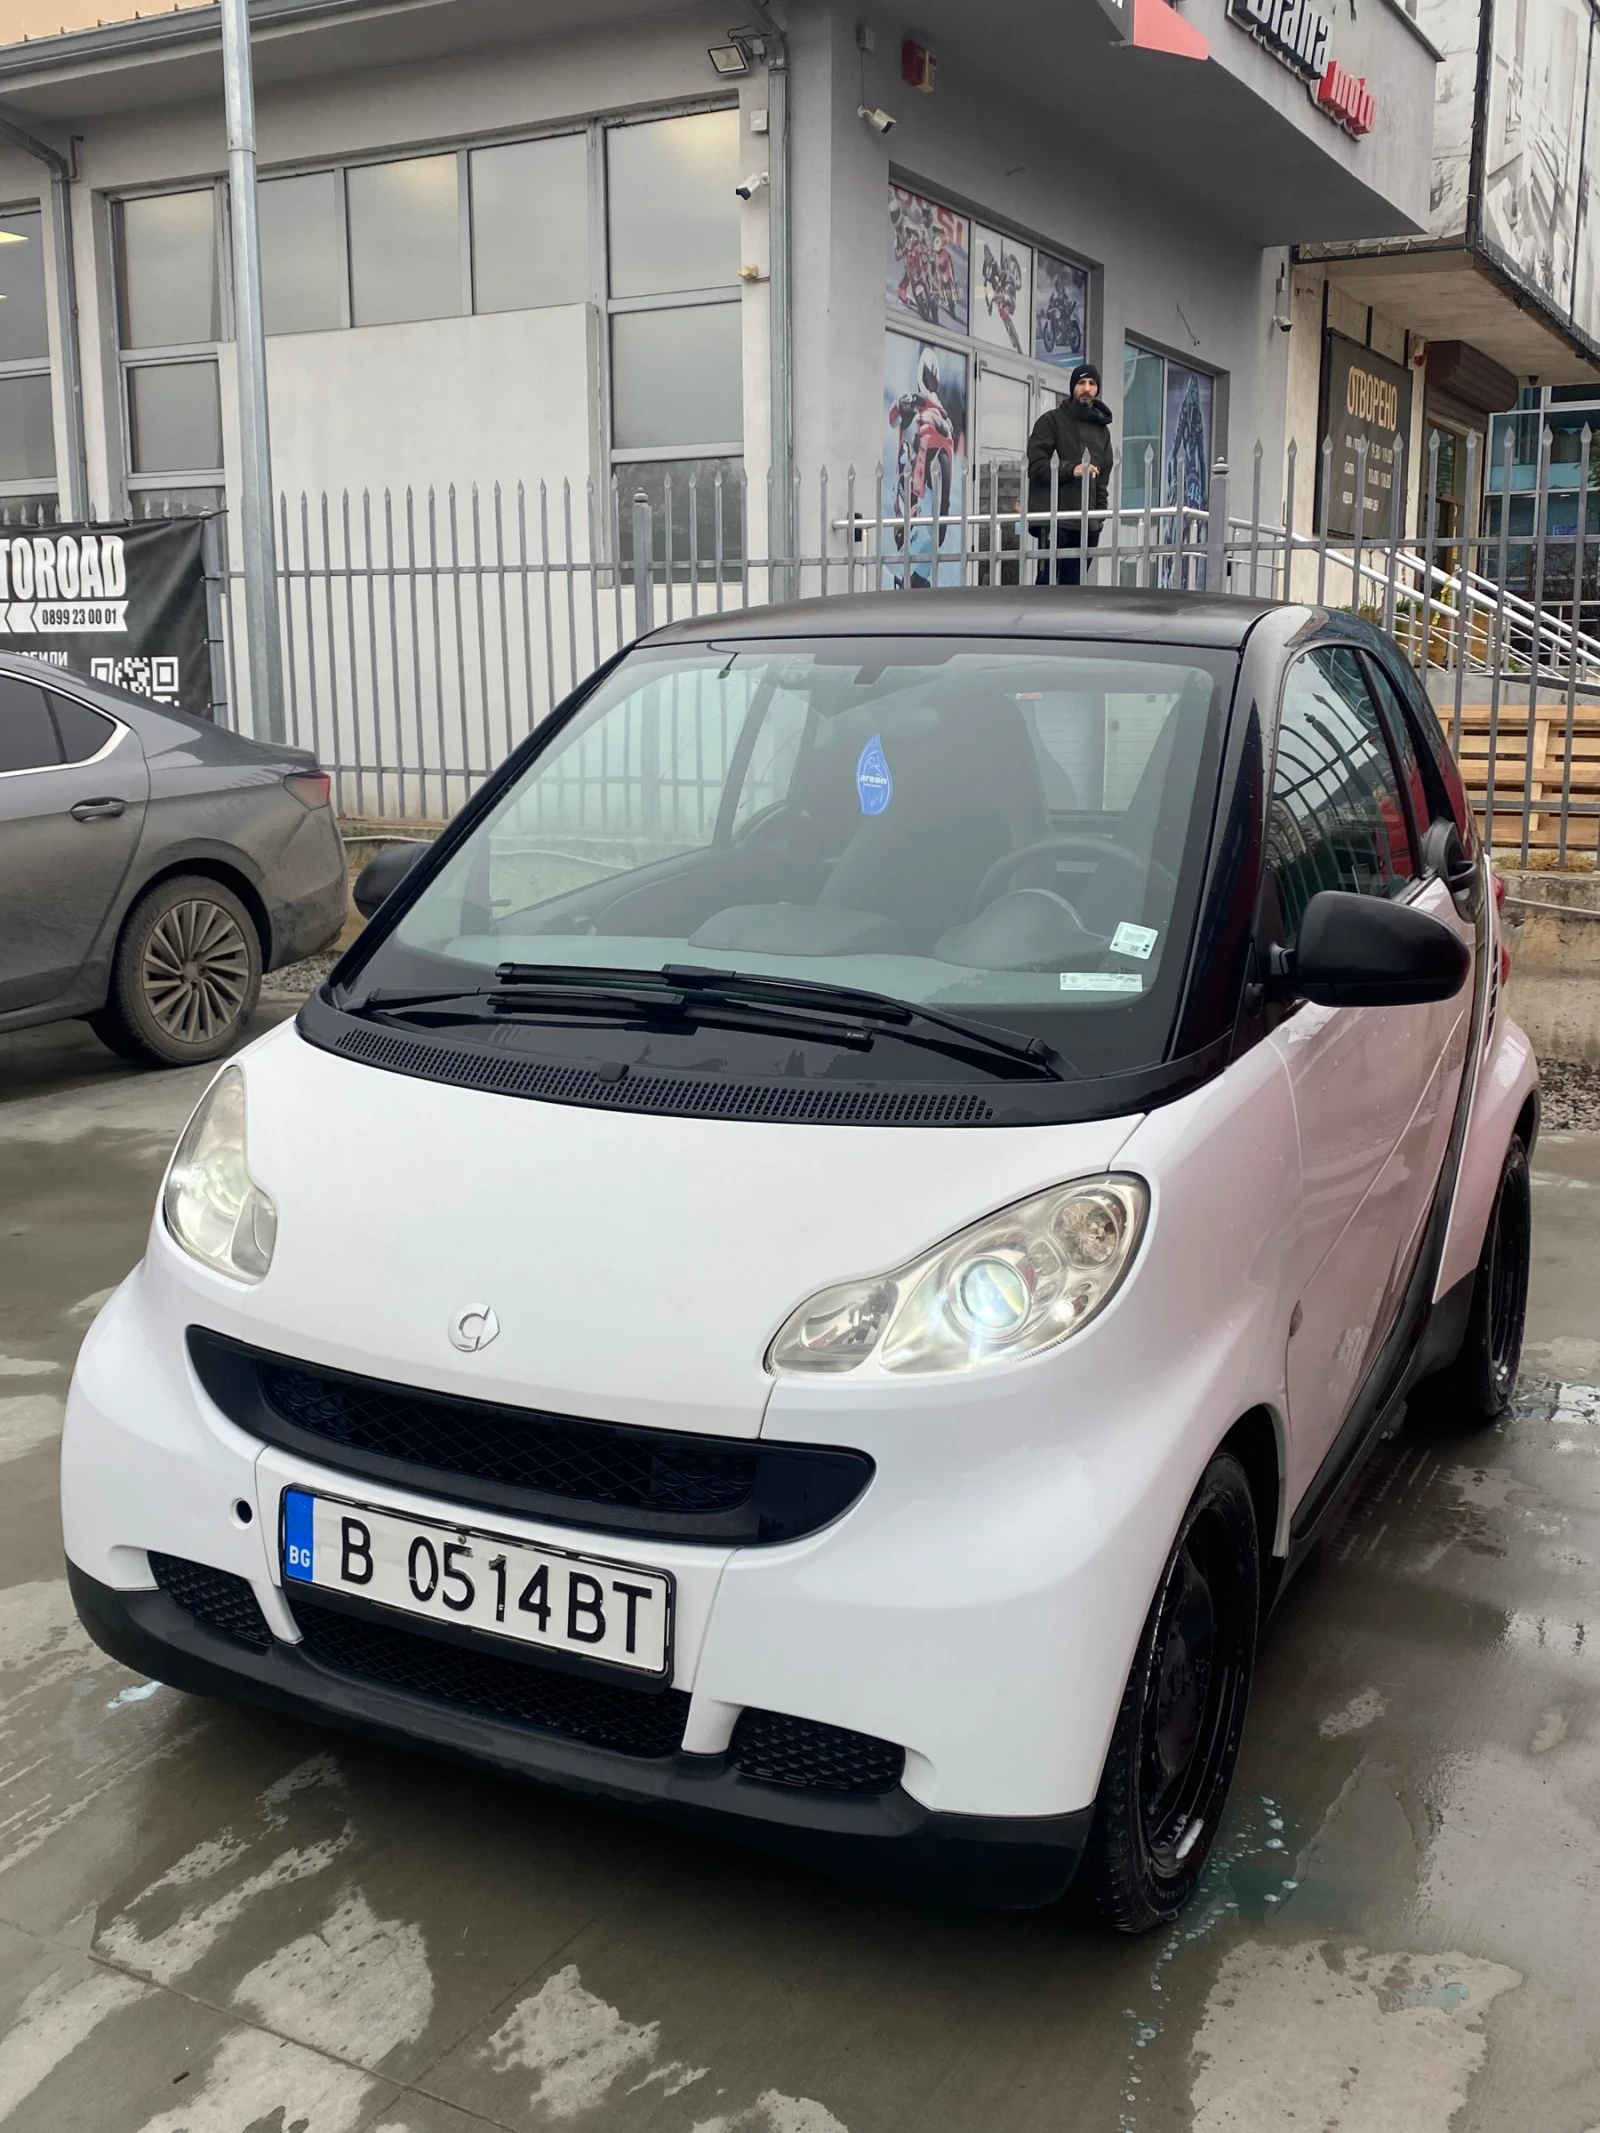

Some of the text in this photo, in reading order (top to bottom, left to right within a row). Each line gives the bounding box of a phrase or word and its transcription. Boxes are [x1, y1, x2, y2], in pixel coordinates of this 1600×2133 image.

[1347, 365, 1397, 432] ОТВОРЕНО
[0, 535, 126, 600] TOROAD
[42, 607, 117, 625] 0899 23 00 01
[859, 774, 887, 785] areon
[290, 1545, 310, 1568] BG
[341, 1516, 373, 1585] B
